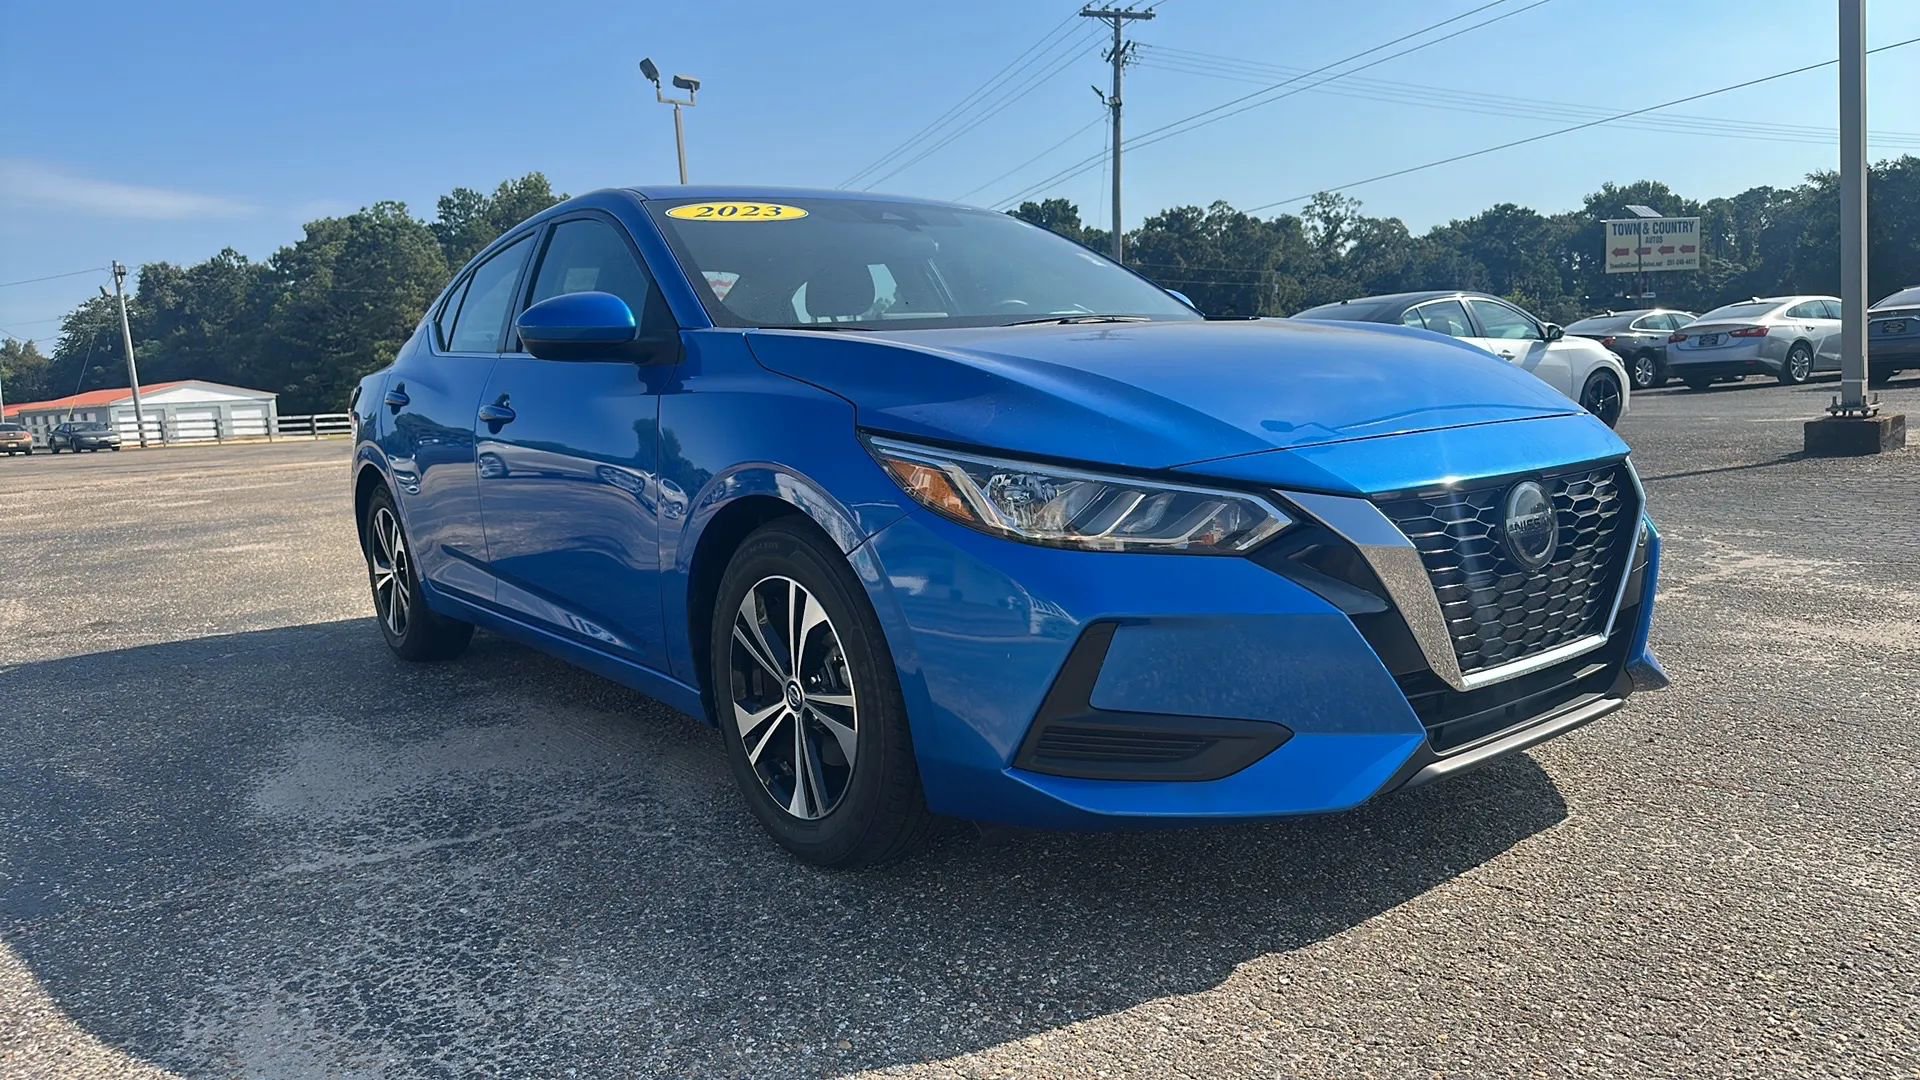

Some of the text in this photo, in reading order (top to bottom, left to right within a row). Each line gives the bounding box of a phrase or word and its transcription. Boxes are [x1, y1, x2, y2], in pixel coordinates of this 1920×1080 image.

[694, 205, 782, 218] 2023
[1612, 221, 1694, 236] TOWN & COUNTRY
[1645, 235, 1663, 244] AUTOS
